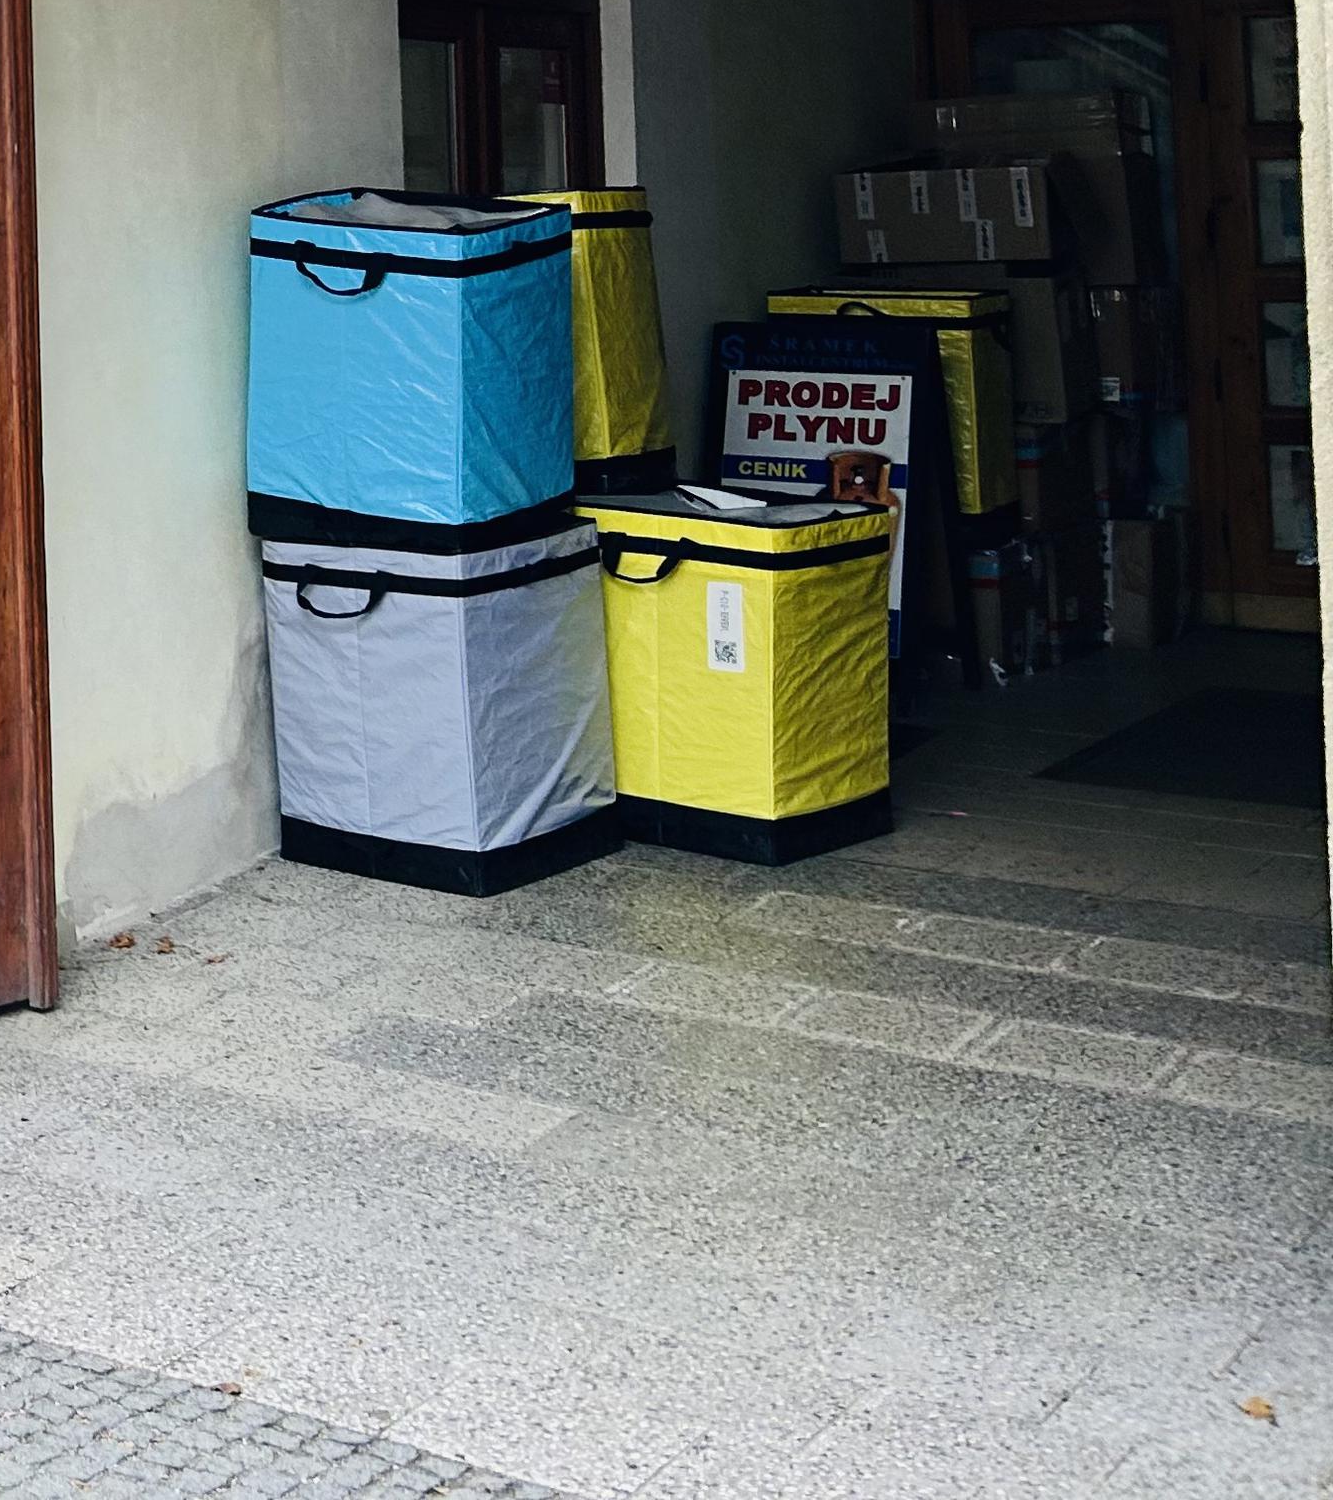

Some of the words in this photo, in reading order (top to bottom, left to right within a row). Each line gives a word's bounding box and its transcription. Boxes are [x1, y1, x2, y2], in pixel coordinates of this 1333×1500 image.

[738, 378, 902, 411] PRODEJ
[747, 412, 887, 445] PLYNU
[738, 460, 808, 479] CENÍK
